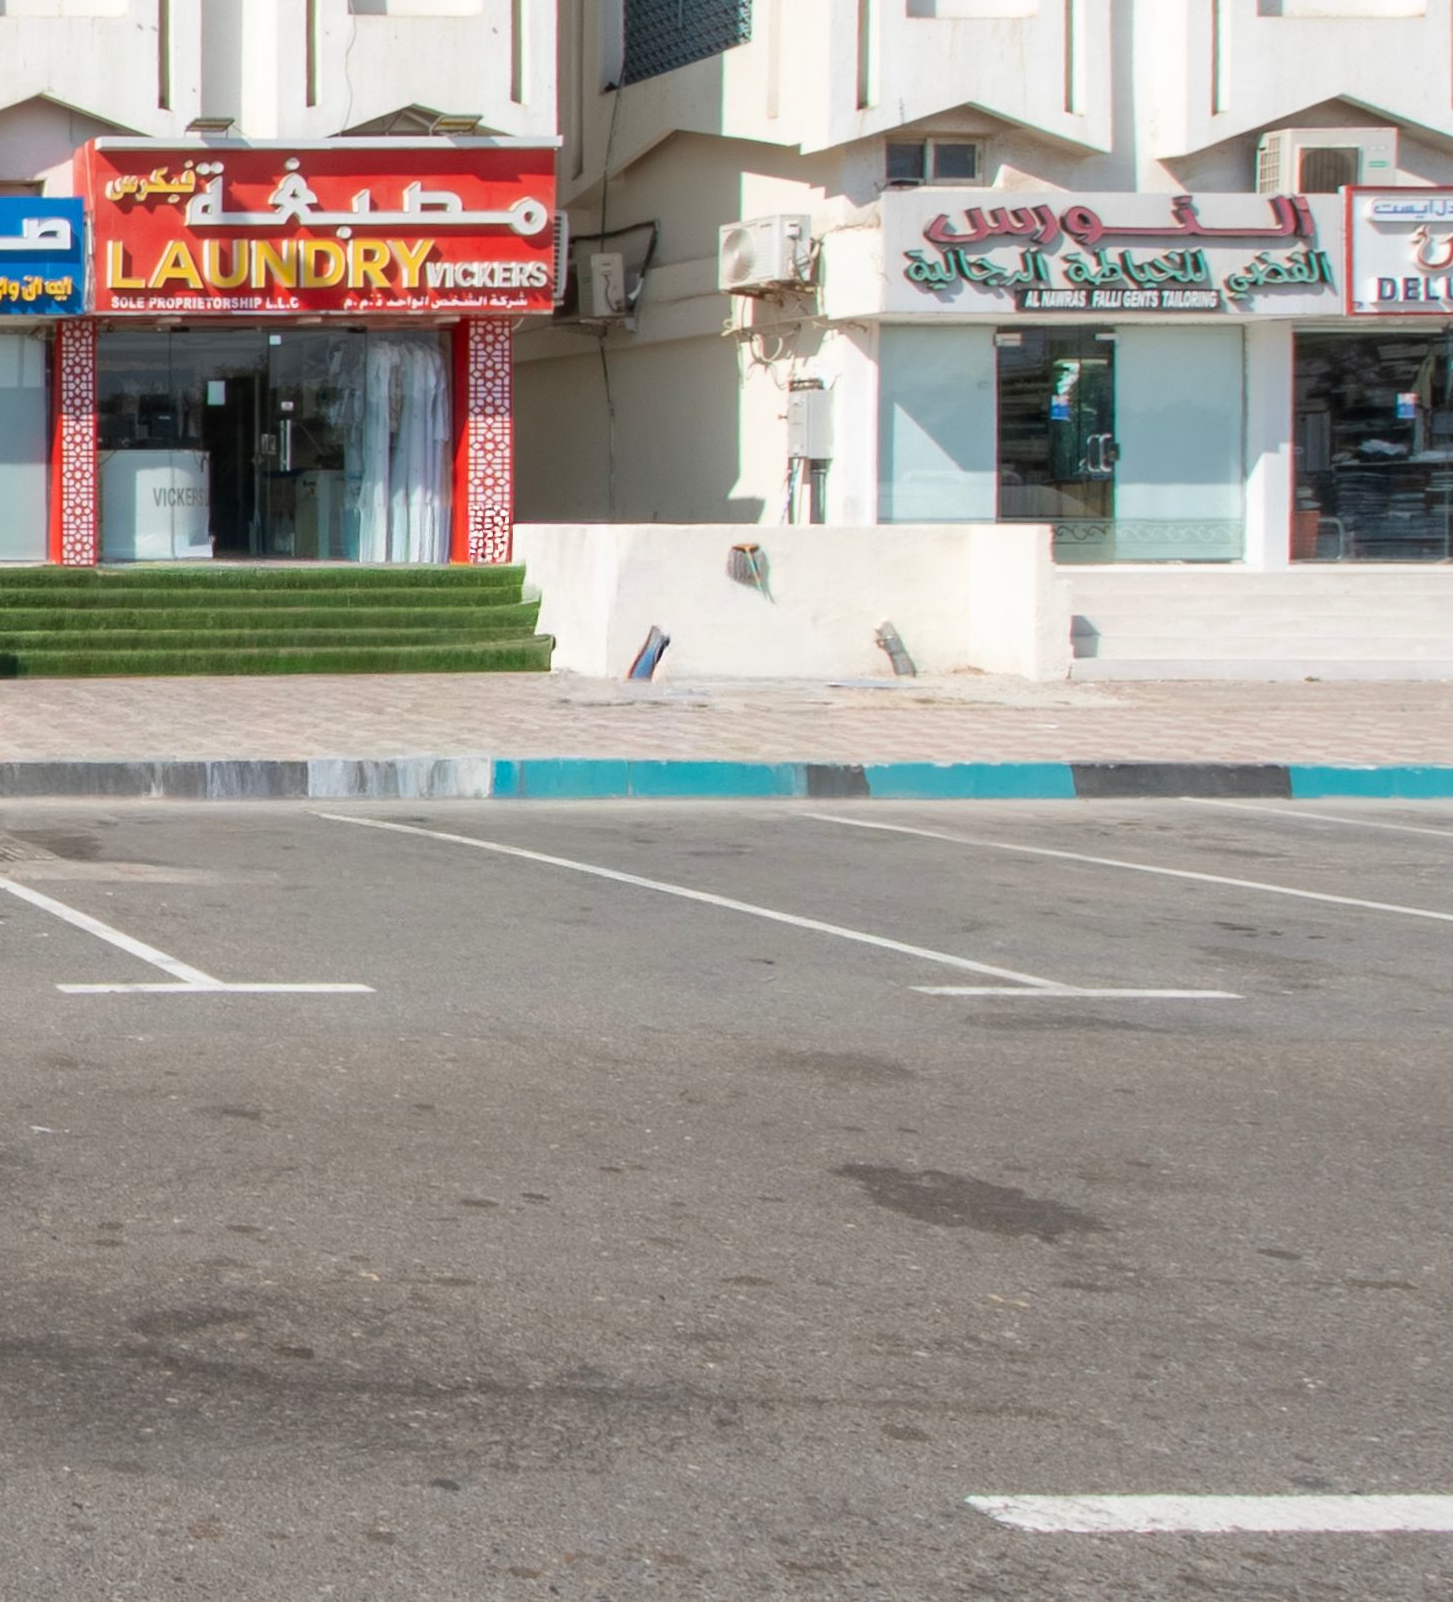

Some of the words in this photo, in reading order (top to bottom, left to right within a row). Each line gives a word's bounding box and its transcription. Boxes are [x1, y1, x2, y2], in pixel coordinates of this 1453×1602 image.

[185, 157, 549, 240] مصبغة
[923, 195, 1316, 246] النورس
[106, 239, 434, 290] LAUNDRY
[426, 261, 548, 290] VICKERS
[905, 248, 1049, 291] الرجالية
[1065, 248, 1207, 290] للخياطة
[111, 296, 145, 310] SOLE
[148, 296, 262, 310] PROPRIETORSHIP
[386, 295, 430, 310] الواحد
[431, 292, 488, 310] الشخص
[489, 291, 529, 310] شركة
[1025, 290, 1041, 308] AL
[1041, 290, 1087, 308] NAWRAS
[1123, 290, 1160, 308] GENTS
[1161, 290, 1219, 309] TAILORING
